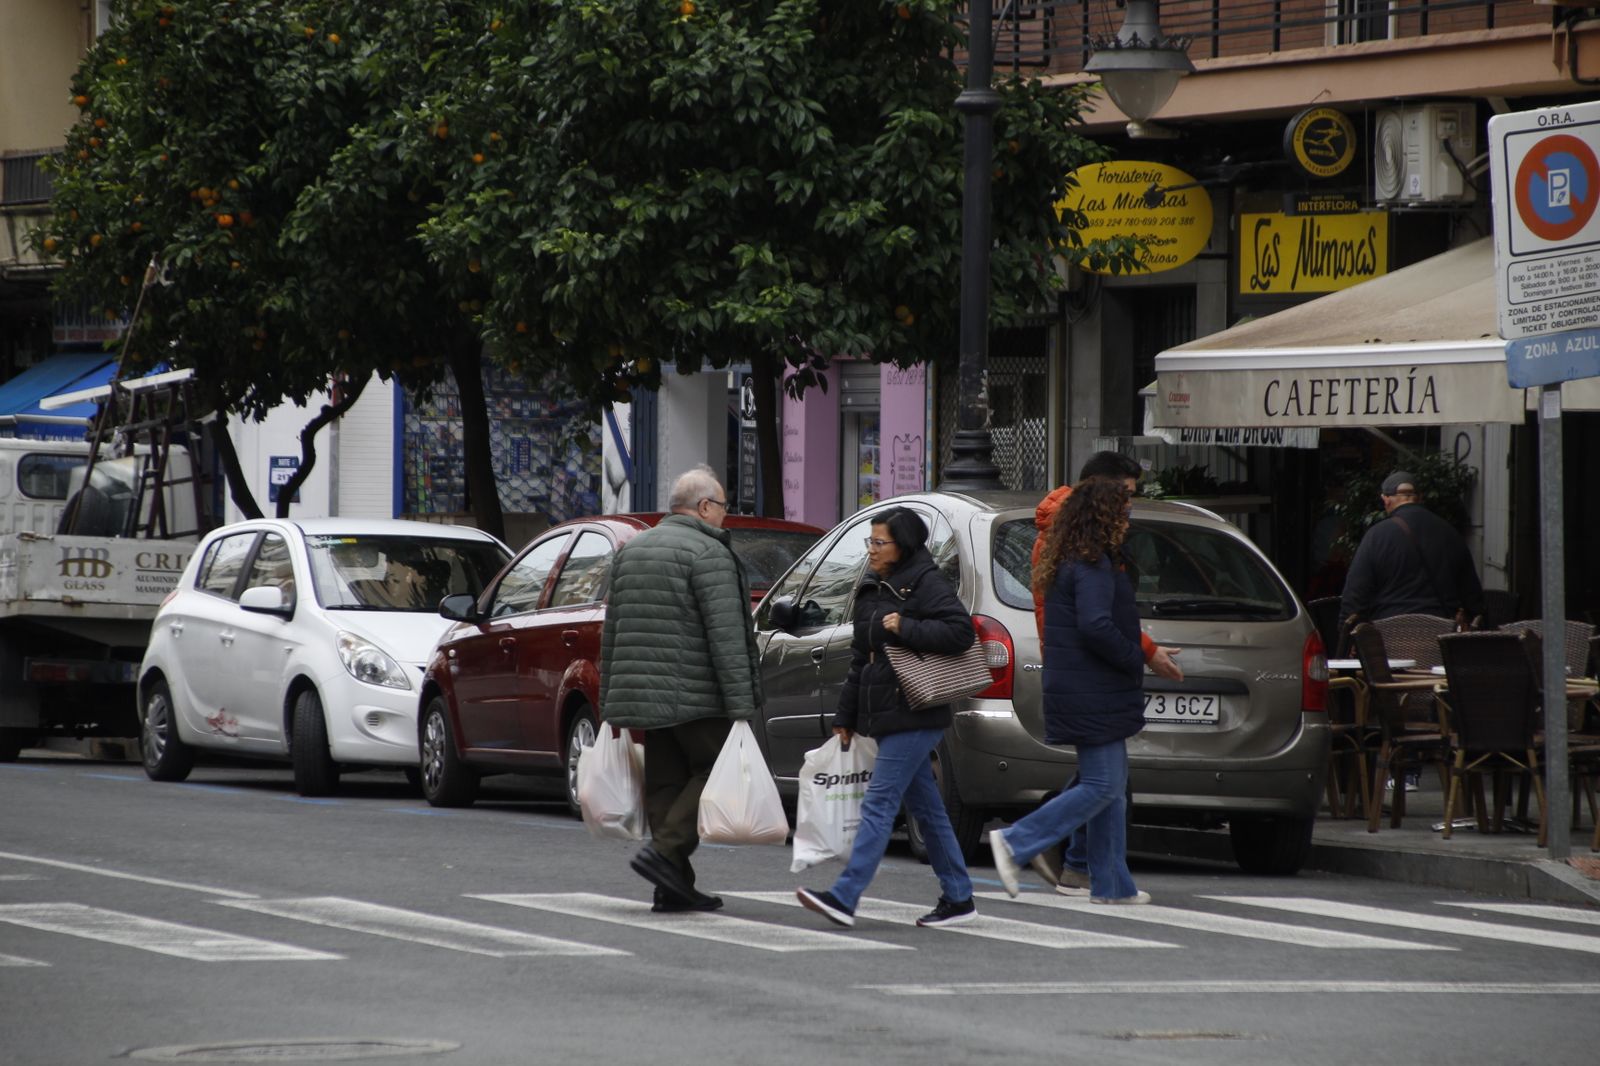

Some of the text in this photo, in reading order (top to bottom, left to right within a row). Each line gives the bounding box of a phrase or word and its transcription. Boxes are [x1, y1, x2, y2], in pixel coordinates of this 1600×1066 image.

[1537, 112, 1575, 126] O.R.A.
[1077, 192, 1189, 212] Las Mimsas
[1298, 200, 1358, 212] INTERFLORA
[1250, 217, 1376, 291] Las Mimosas
[1527, 263, 1546, 272] Lunes
[1557, 257, 1581, 267] Viernes
[1523, 288, 1553, 298] Domingos
[1508, 308, 1528, 316] ZONA
[1513, 313, 1547, 325] LIMITADO
[1522, 315, 1598, 333] TICKET OBLIGATORIO
[1524, 335, 1600, 359] ZONA AZUL
[1264, 367, 1440, 417] CAFETERÍA
[64, 580, 105, 591] GLASS
[1175, 695, 1215, 716] GCZ
